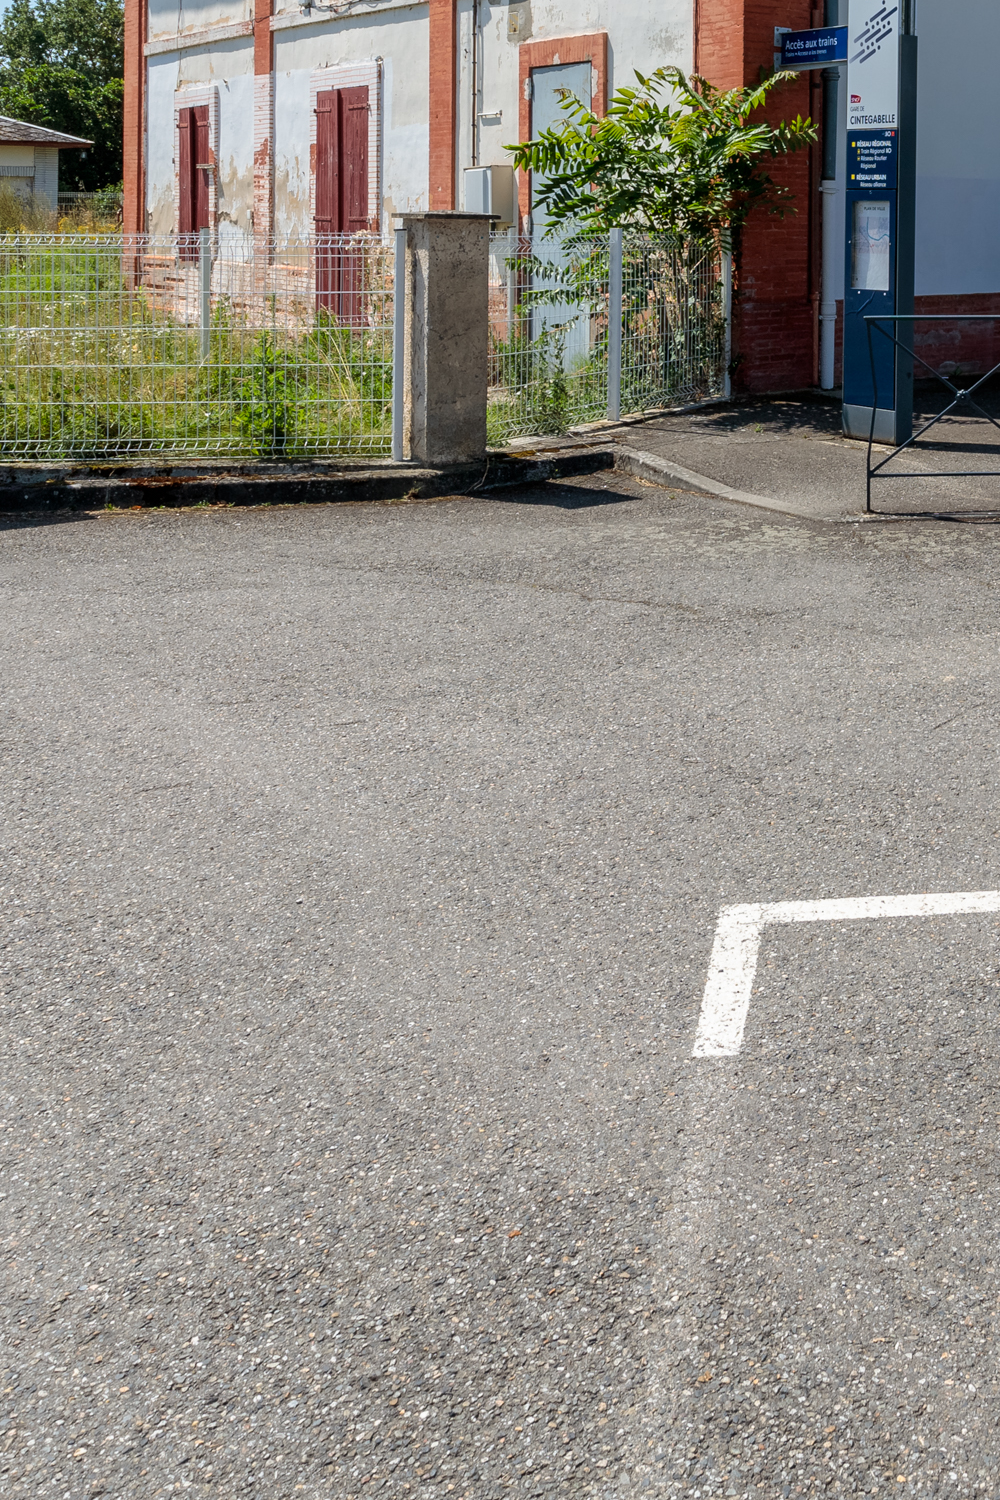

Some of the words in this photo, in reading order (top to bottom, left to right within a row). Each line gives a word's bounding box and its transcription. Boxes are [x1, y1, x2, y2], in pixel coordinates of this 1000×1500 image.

[785, 39, 804, 50] Accès
[805, 40, 817, 49] aux
[818, 36, 838, 47] trains
[850, 114, 895, 125] CINTEGABELLE
